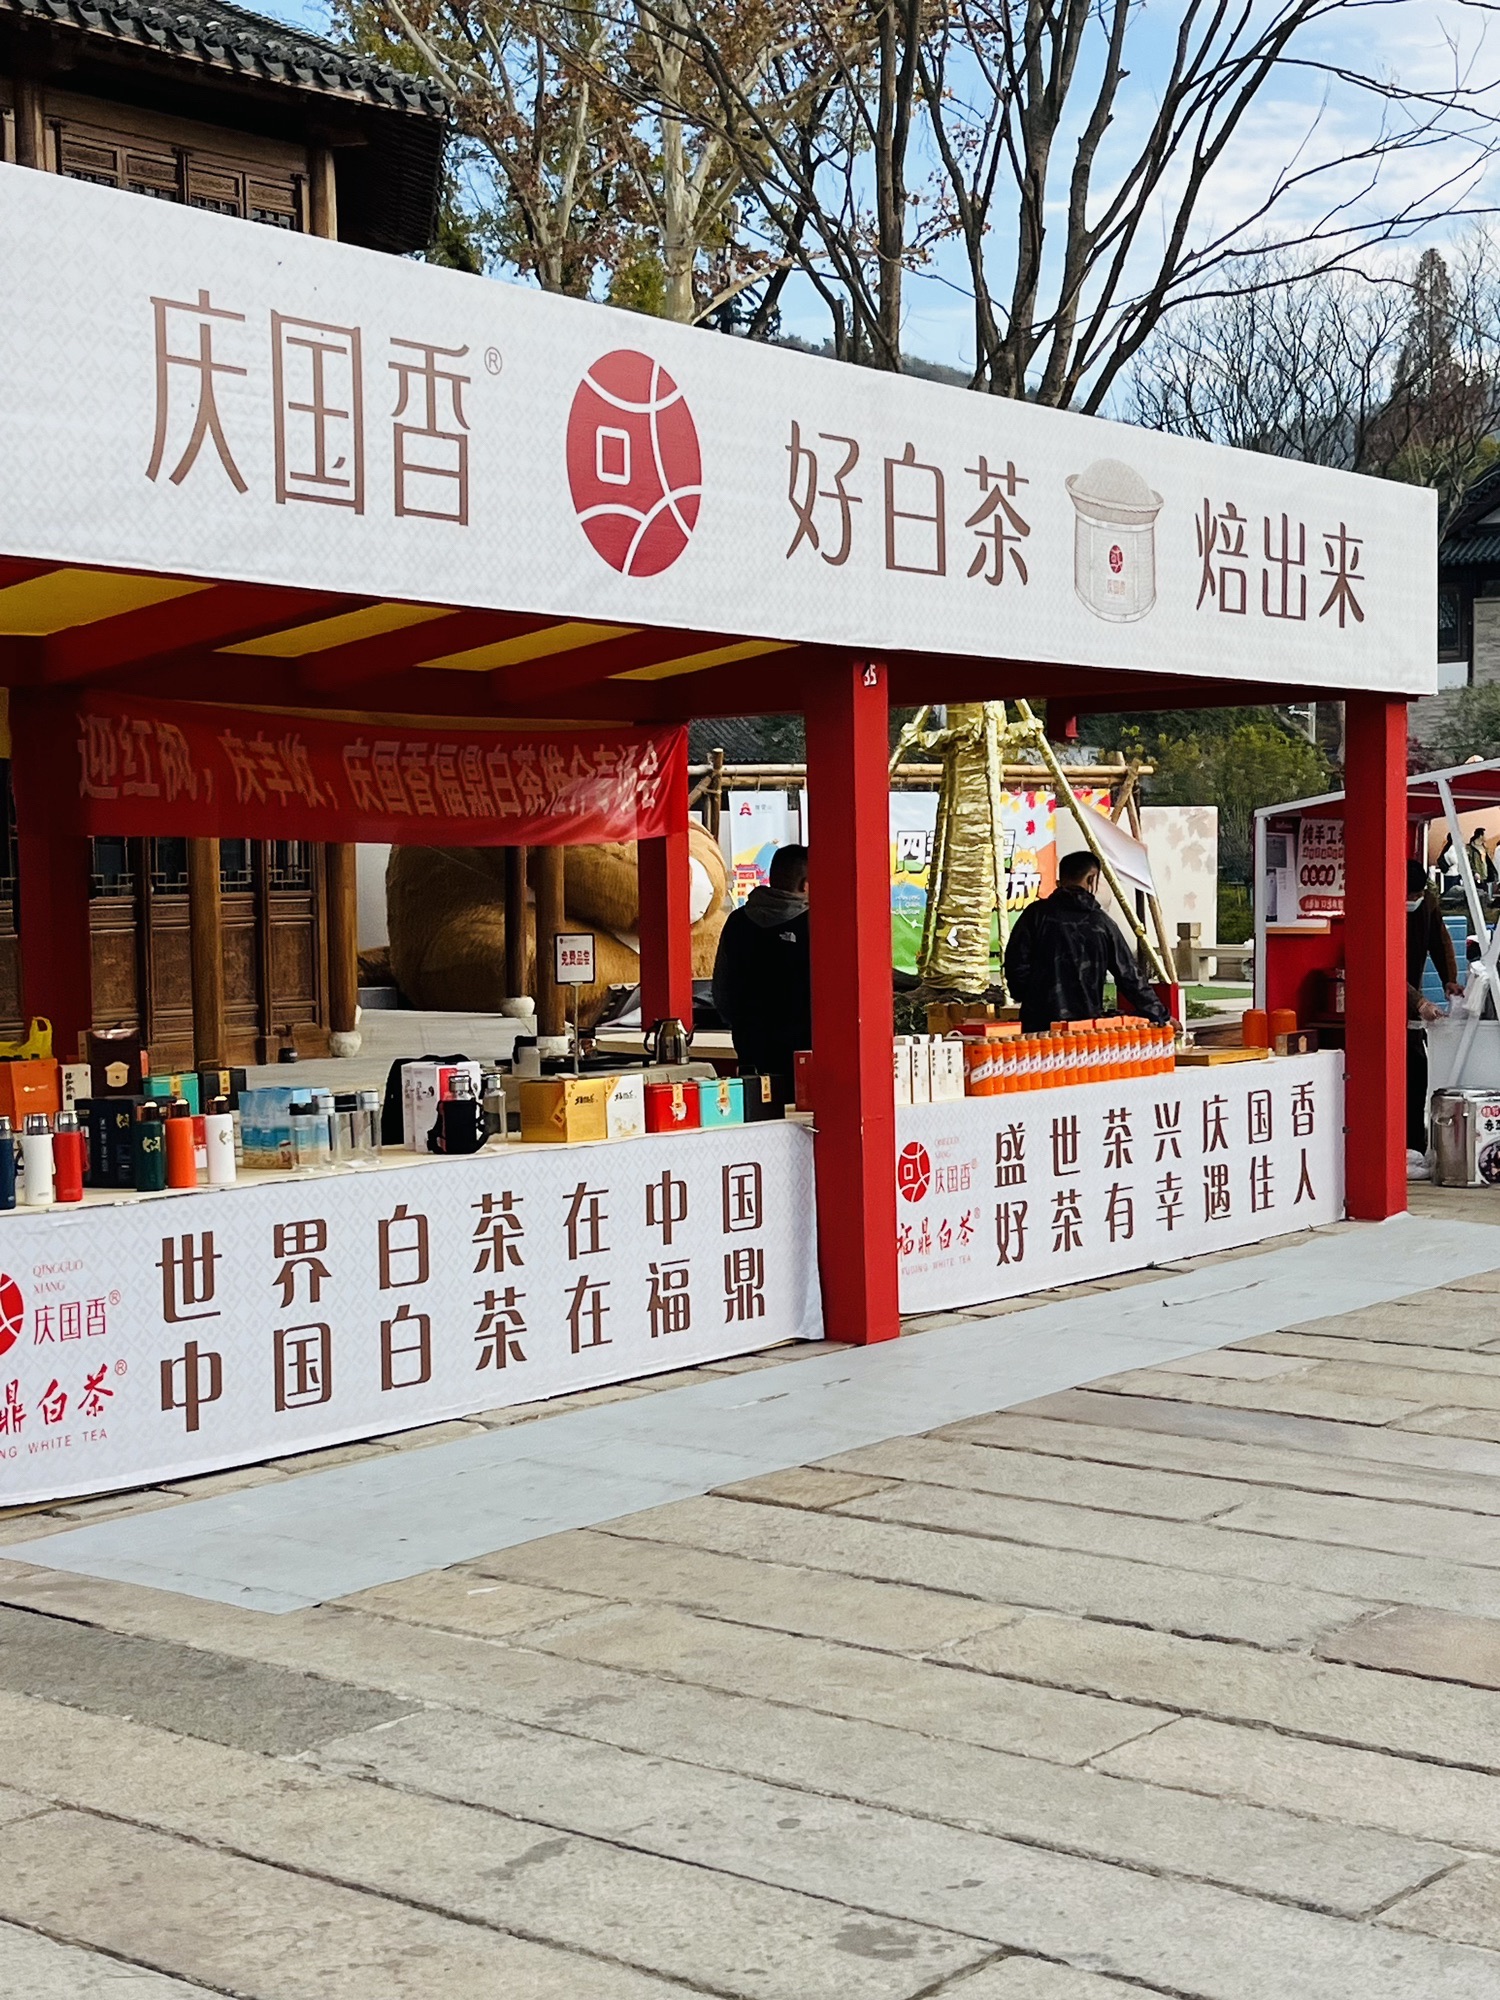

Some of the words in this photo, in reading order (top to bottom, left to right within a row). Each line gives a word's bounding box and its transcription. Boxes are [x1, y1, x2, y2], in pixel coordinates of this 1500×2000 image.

[785, 419, 1033, 587] 好白茶
[1195, 497, 1366, 629] 焙出来
[994, 1080, 1316, 1189] 盛世茶兴庆国香
[155, 1160, 764, 1325] 世界白茶在中国
[994, 1148, 1316, 1268] 好茶有幸遇佳人
[159, 1247, 766, 1433] 中国白茶在福鼎
[28, 1434, 73, 1454] WHITE
[82, 1428, 108, 1443] TEA
